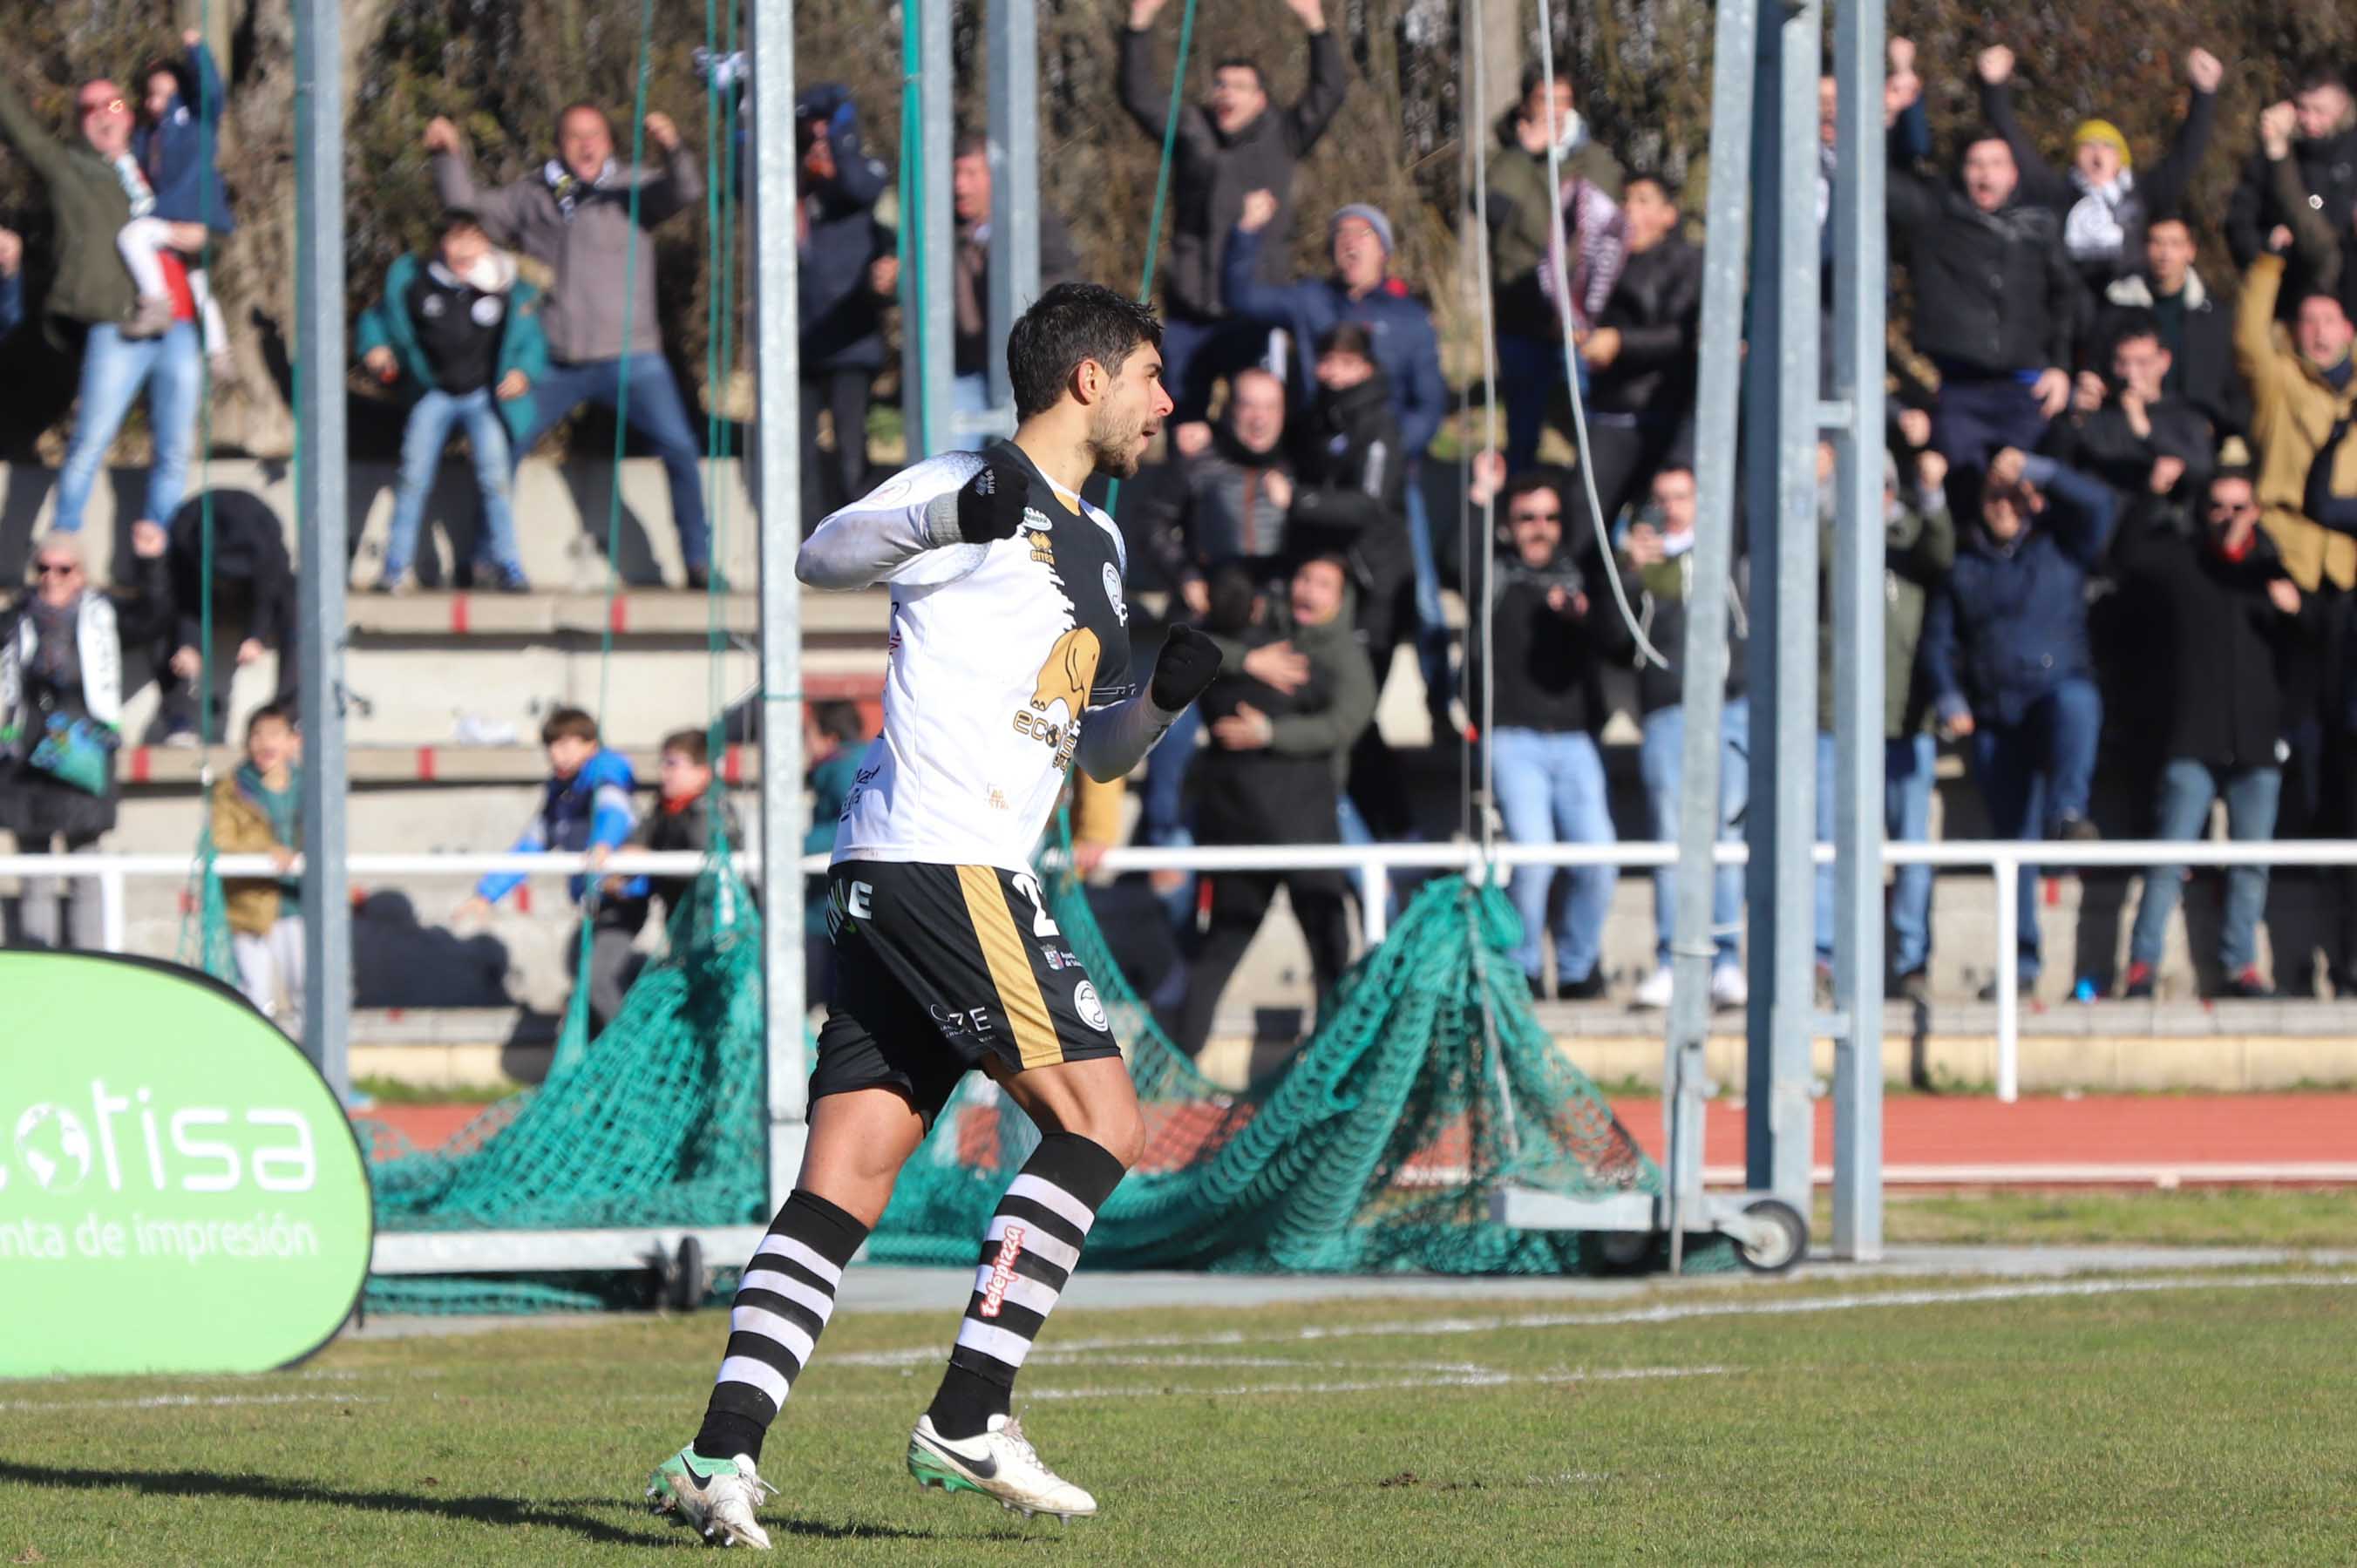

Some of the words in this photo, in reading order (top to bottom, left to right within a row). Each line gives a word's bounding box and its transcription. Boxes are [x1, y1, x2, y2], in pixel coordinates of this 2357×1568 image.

[0, 1077, 317, 1194] otisa
[74, 1212, 126, 1259] de
[133, 1212, 320, 1266] impresión
[980, 1225, 1025, 1317] telepizza
